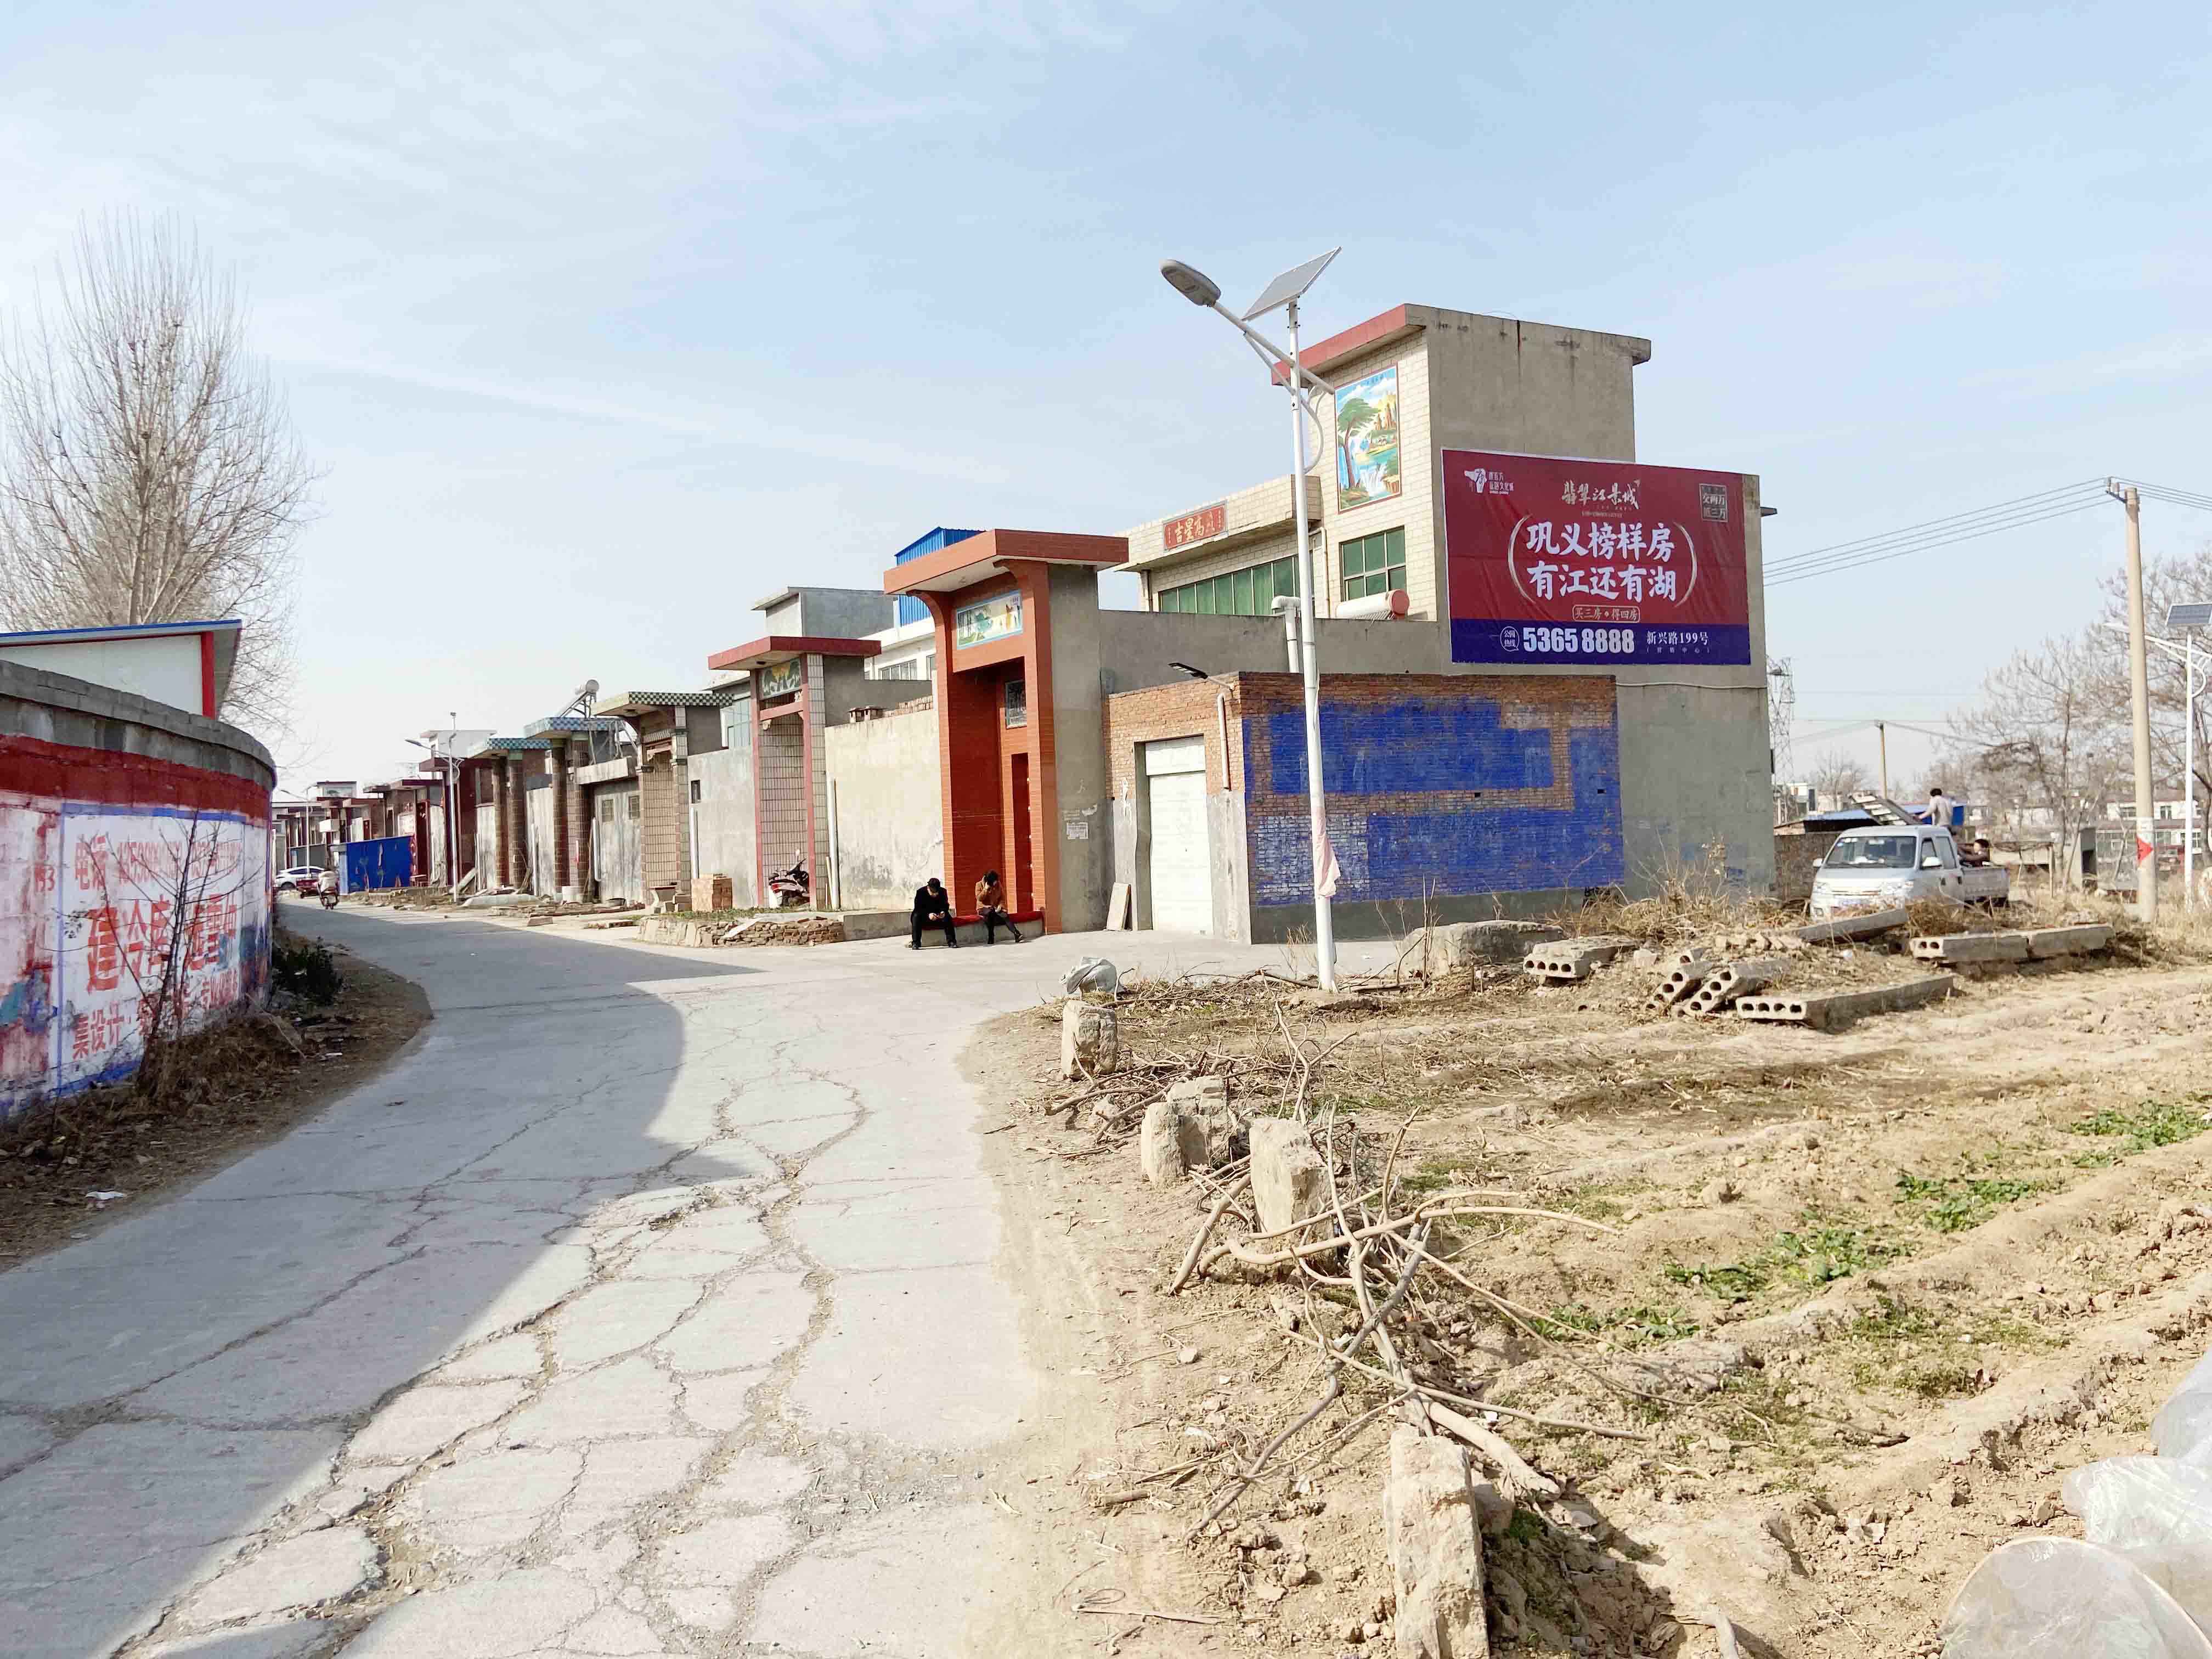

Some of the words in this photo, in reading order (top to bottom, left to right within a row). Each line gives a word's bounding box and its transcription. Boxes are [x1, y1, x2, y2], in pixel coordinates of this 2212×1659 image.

[1526, 522, 1675, 562] 巩义榜样房
[1527, 561, 1676, 602] 有江还有湖
[1646, 630, 1709, 646] 新兴路199号
